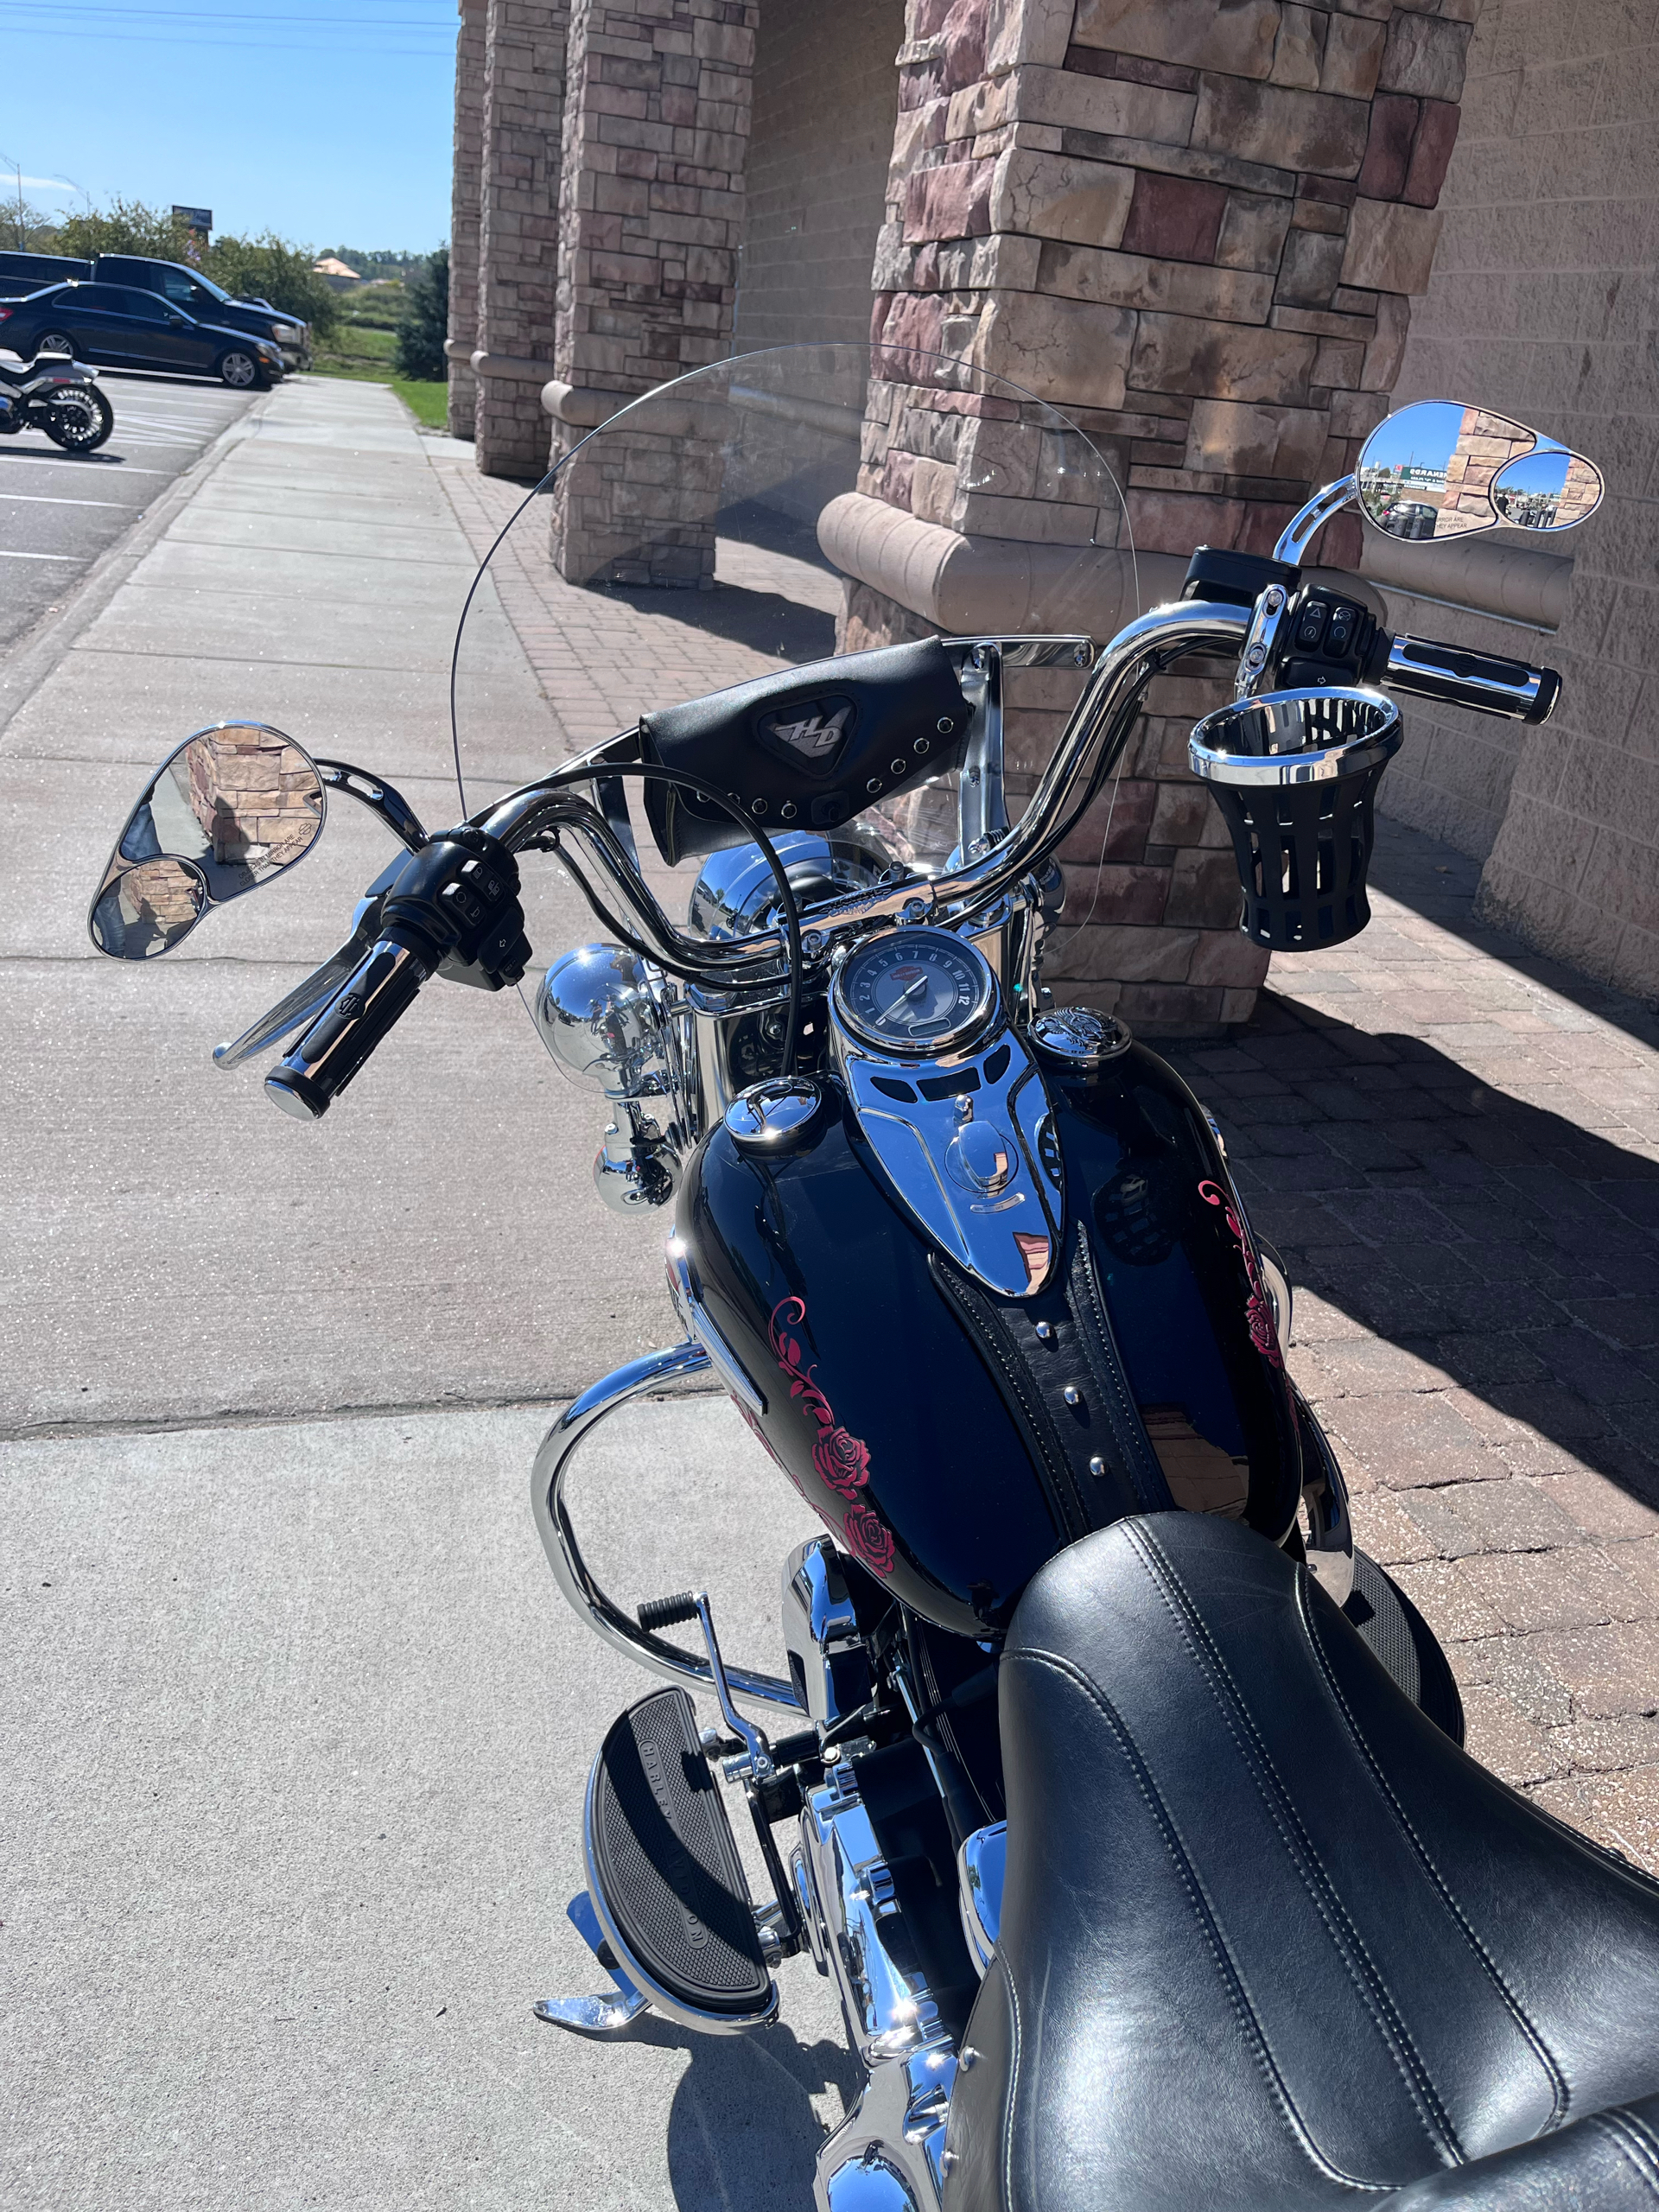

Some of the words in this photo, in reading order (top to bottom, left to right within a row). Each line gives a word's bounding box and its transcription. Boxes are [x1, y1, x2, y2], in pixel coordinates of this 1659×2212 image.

[284, 834, 295, 844] ARE
[240, 870, 259, 887] CLOSER
[271, 850, 285, 863] THEY
[284, 836, 302, 854] APPEAR
[912, 950, 918, 959] 7
[929, 953, 938, 962] 8
[879, 958, 888, 967] 5
[952, 969, 966, 980] 10
[958, 982, 970, 992] 11
[958, 995, 970, 1005] 12
[644, 1745, 672, 1821] HARLEY
